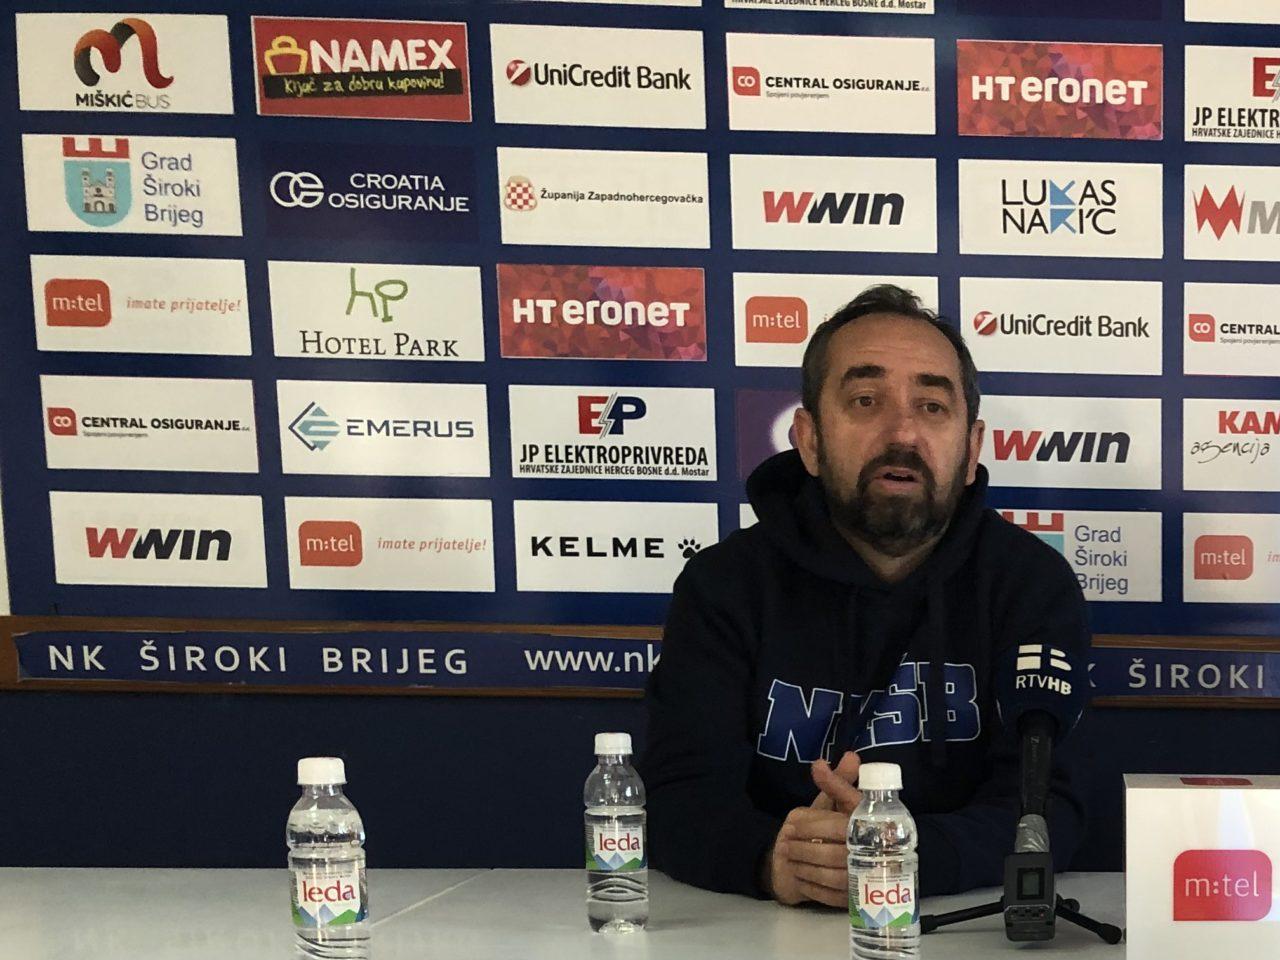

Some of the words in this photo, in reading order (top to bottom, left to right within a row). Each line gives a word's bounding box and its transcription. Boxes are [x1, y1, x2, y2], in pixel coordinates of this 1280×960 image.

[311, 39, 455, 73] NAMEX
[534, 64, 630, 88] UniCredit
[638, 67, 691, 90] Bank
[766, 76, 829, 89] CENTRAL
[833, 79, 920, 91] OSIGURANJE
[972, 76, 1015, 100] HT
[75, 92, 134, 108] MIŠKIĆ
[1193, 107, 1212, 127] JP
[1192, 128, 1231, 138] HRVATSKE
[1234, 129, 1275, 139] ZAJEDNICE
[141, 153, 192, 171] Grad
[143, 175, 200, 196] Široki
[350, 173, 445, 191] CROATIA
[329, 195, 469, 212] OSIGURANJE
[541, 188, 585, 201] Županija
[588, 191, 703, 204] Zapadnohercegovačka
[145, 206, 204, 227] Brijeg
[52, 294, 103, 312] m:tel
[126, 298, 166, 311] imate
[513, 299, 555, 323] HT
[753, 310, 800, 328] m:tel
[1001, 314, 1091, 336] UniCredit
[1098, 317, 1149, 338] Bank
[1220, 323, 1280, 335] CENTRAL
[300, 330, 386, 355] HOTEL
[395, 333, 458, 357] PARK
[82, 416, 147, 429] CENTRAL
[151, 419, 240, 431] OSIGURANJE
[347, 419, 474, 438] EMERUS
[521, 444, 539, 463] JP
[545, 445, 707, 466] ELEKTROPRIVREDA
[519, 464, 559, 474] HRVATSKE
[561, 465, 602, 474] ZAJEDNICE
[605, 466, 635, 475] HERCEG
[637, 467, 662, 476] BOSNE
[664, 466, 679, 476] d.d.
[682, 467, 709, 477] Mostar
[1075, 525, 1121, 543] Grad
[307, 535, 354, 553] m:tel
[378, 538, 415, 551] imate
[419, 538, 486, 554] prijatelje!
[532, 536, 664, 558] KELME
[1075, 544, 1127, 568] Široki
[1201, 548, 1246, 566] m:tel
[49, 645, 106, 671] NK
[140, 639, 286, 672] ŠIROKI
[323, 648, 467, 674] BRIJEG
[524, 644, 663, 674] www.nk
[1129, 658, 1263, 689] ŠIROKI
[1016, 674, 1072, 695] RTVHB
[600, 832, 640, 851] leda
[302, 881, 355, 902] leda
[865, 883, 912, 905] leda
[1185, 870, 1259, 898] m:tel
